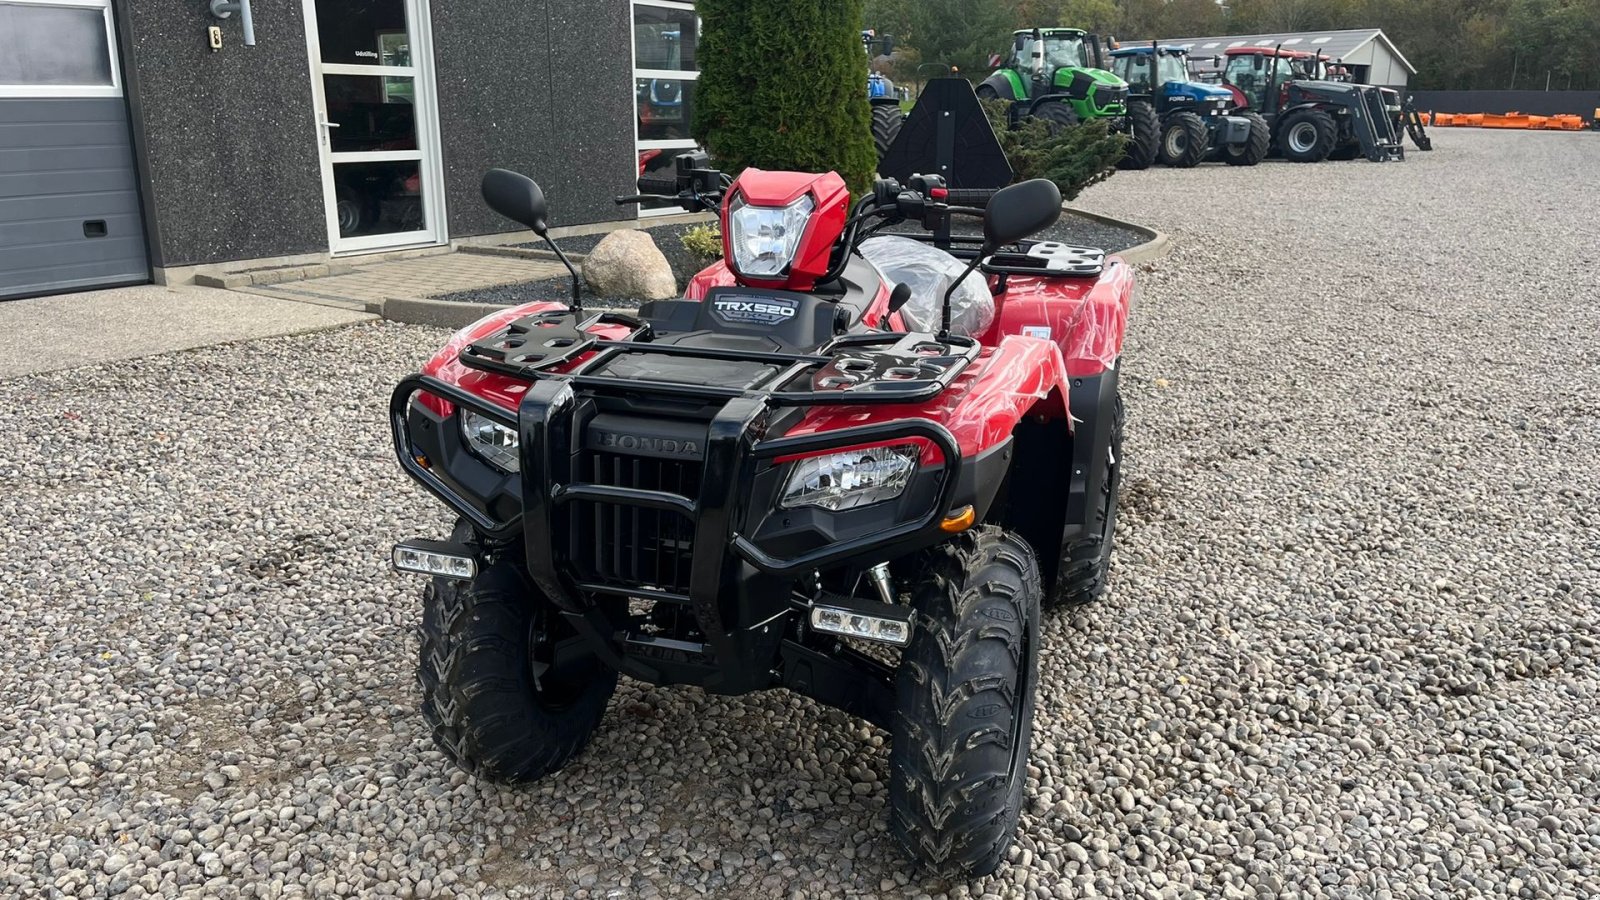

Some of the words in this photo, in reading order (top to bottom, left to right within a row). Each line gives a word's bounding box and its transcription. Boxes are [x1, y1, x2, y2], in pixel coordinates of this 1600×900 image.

[355, 50, 378, 59] Udstilling
[714, 301, 795, 317] TRX520
[597, 431, 703, 455] HONDA
